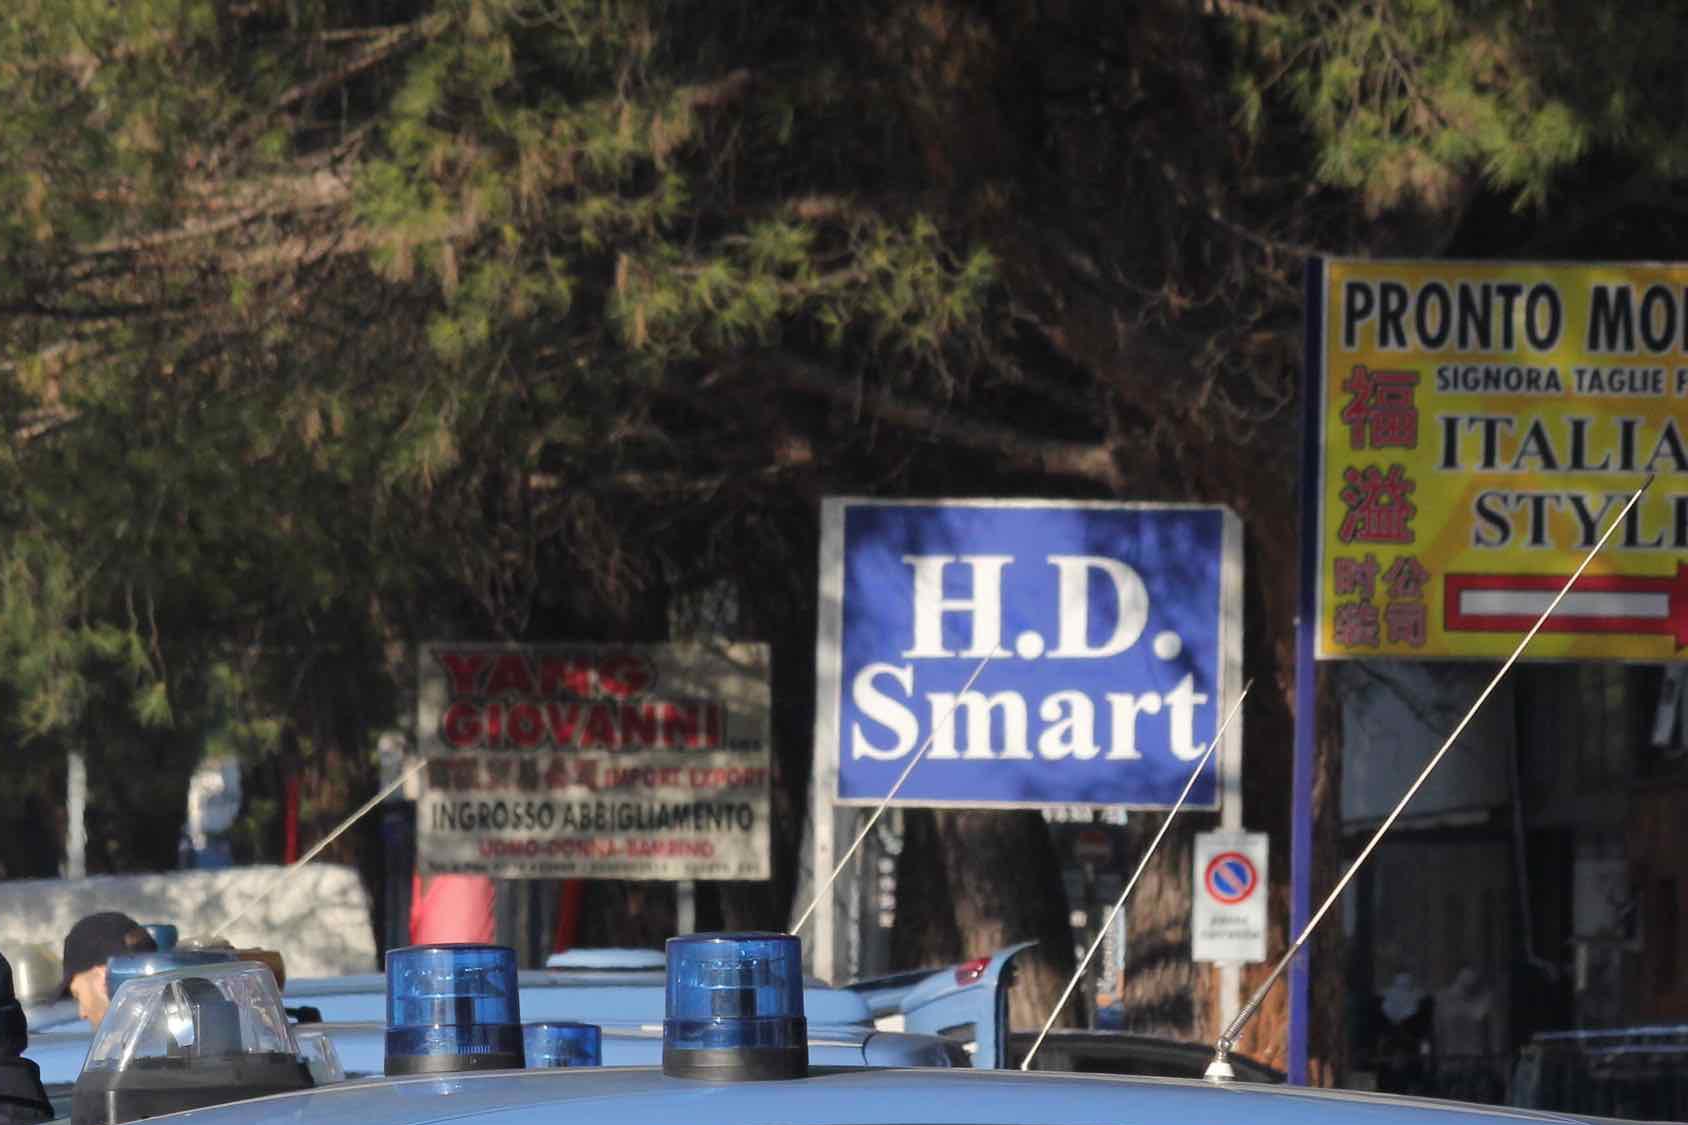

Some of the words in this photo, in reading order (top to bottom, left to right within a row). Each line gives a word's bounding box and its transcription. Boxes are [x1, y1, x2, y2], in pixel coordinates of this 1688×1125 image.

[1343, 281, 1561, 352] PRONTO
[1588, 284, 1688, 354] MO
[1436, 366, 1562, 393] SIGNORA
[1574, 368, 1665, 395] TAGLIE
[902, 554, 1182, 661] H.D.
[443, 701, 723, 750] GIOVANNI
[852, 662, 1208, 761] Smart
[431, 801, 555, 832] INGROSSO
[562, 801, 754, 832] ABBIGLIAMENTO
